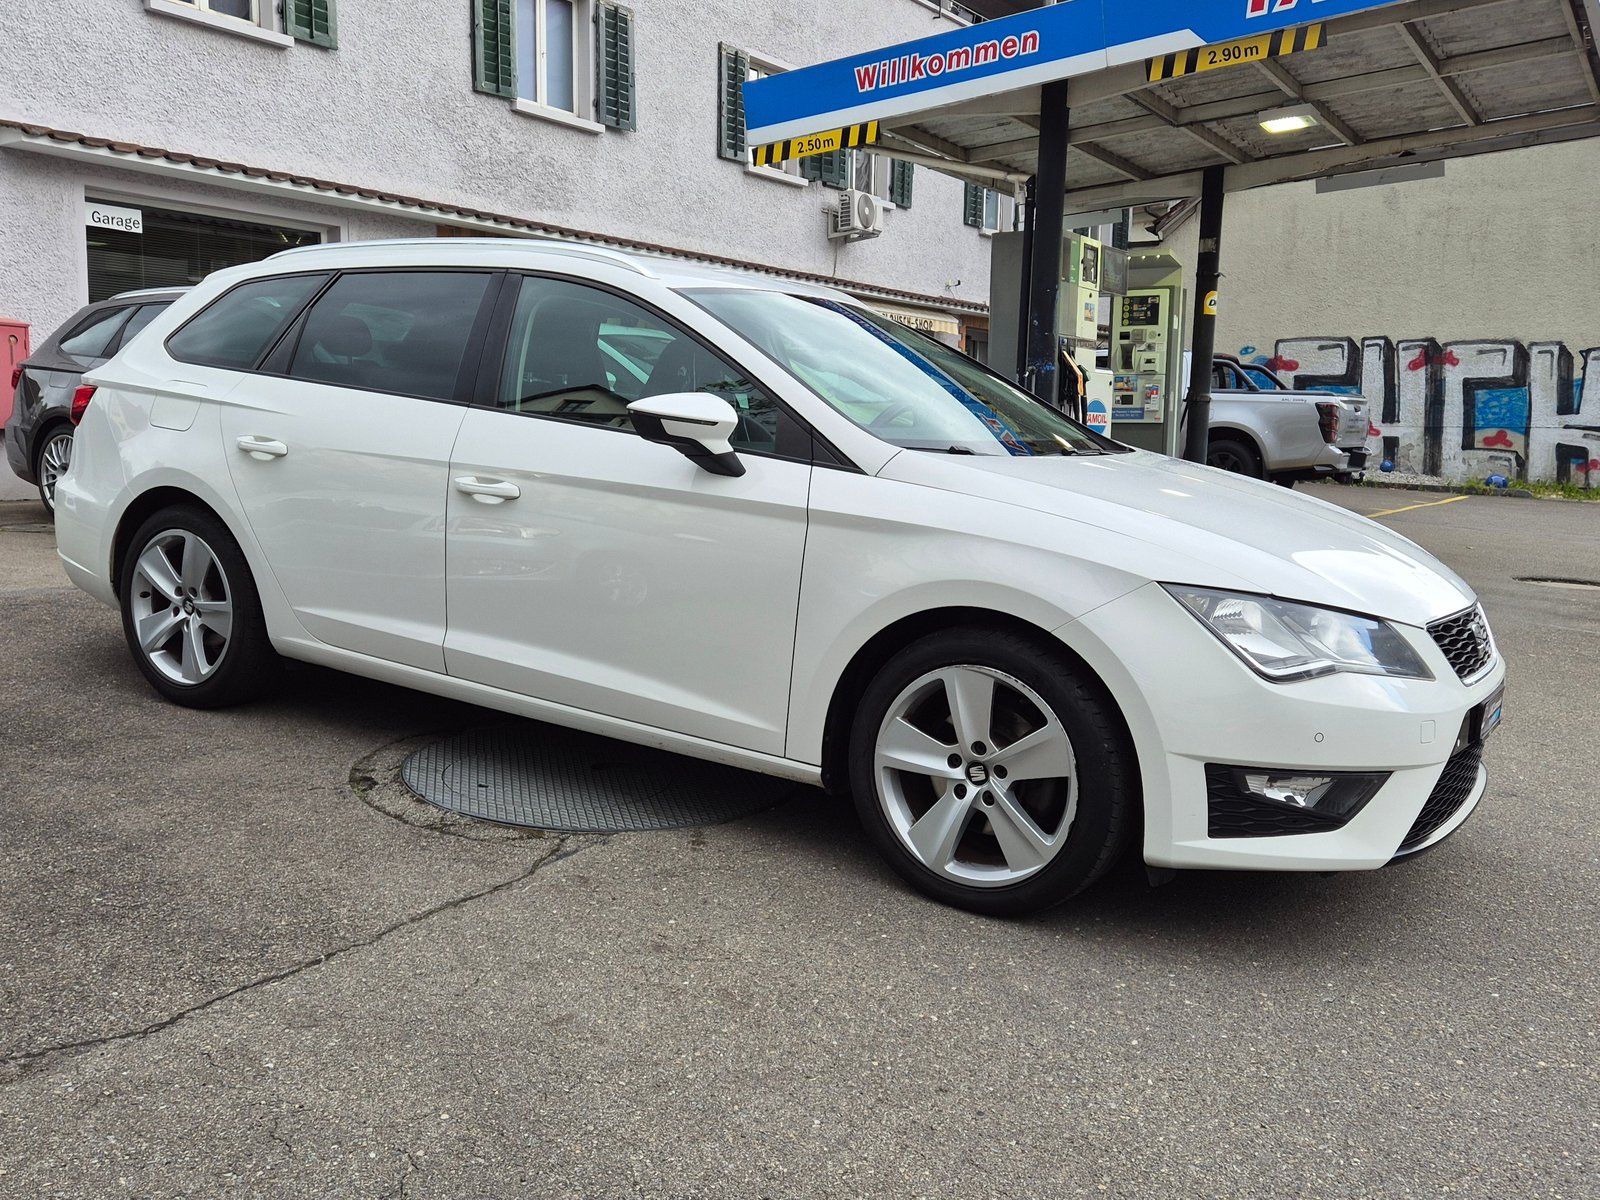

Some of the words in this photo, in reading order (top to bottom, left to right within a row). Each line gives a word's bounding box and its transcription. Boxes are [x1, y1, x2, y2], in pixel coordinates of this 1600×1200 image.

[854, 30, 1040, 93] Willkommen
[91, 210, 140, 230] Garage
[1087, 413, 1107, 424] AMOIL
